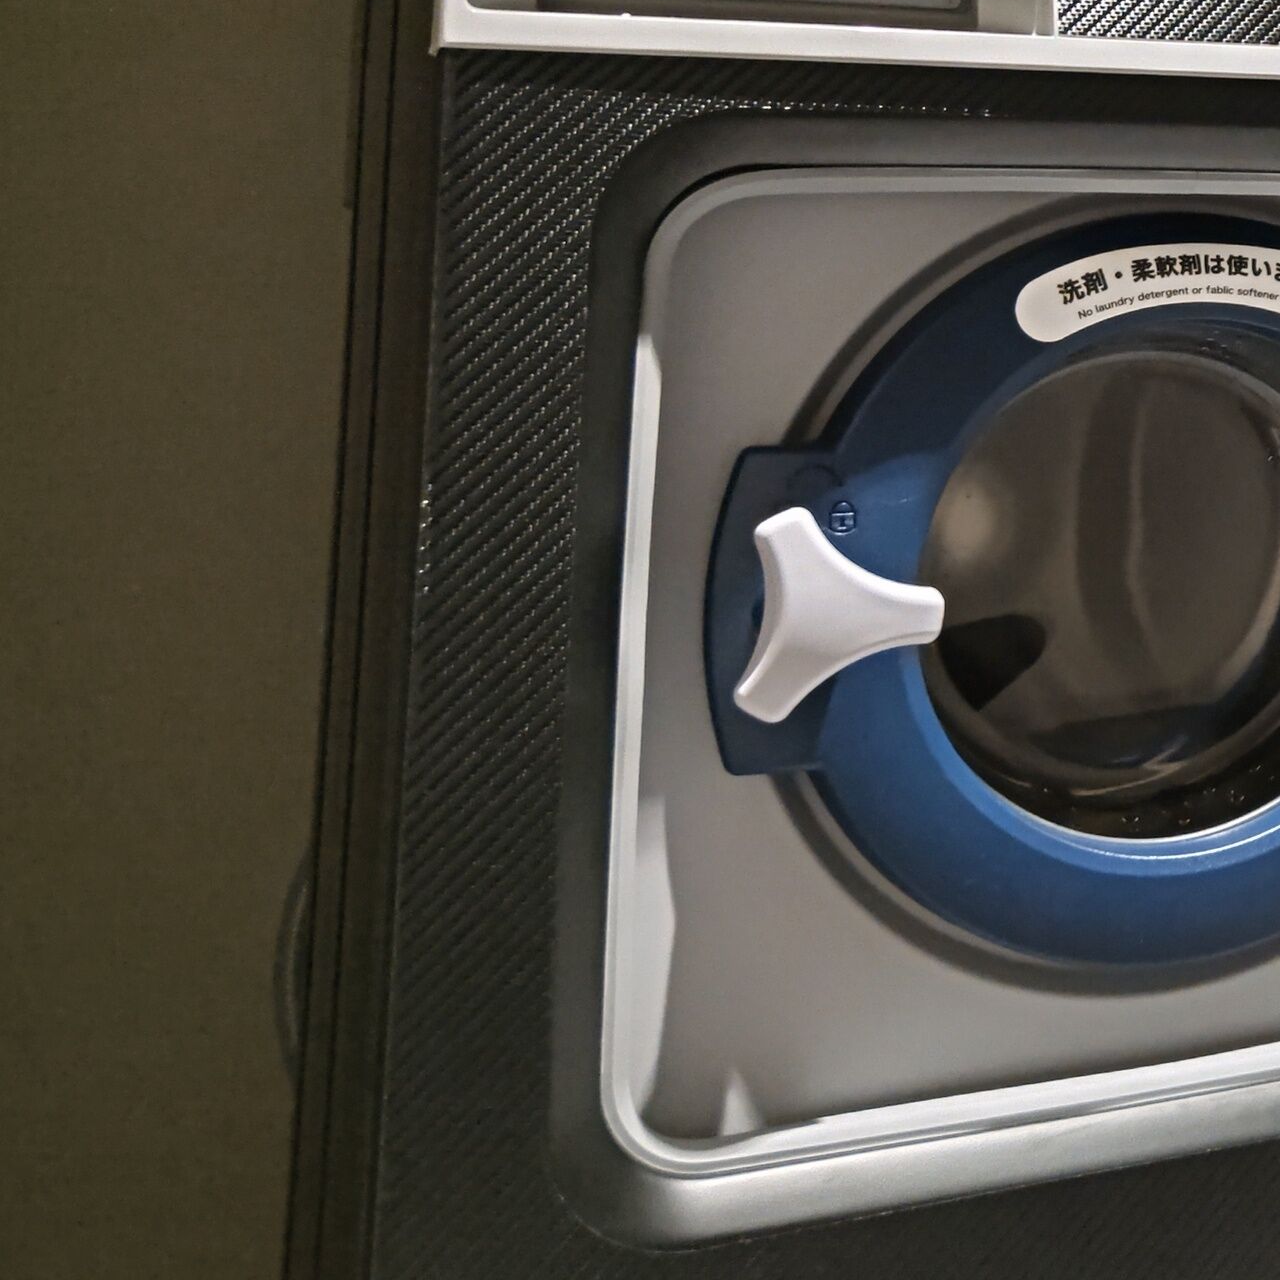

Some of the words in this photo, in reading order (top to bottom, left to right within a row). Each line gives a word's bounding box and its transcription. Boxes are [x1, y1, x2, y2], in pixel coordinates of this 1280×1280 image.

[1078, 309, 1093, 320] No
[1095, 295, 1135, 312] laundry
[1138, 286, 1189, 302] detergent
[1192, 287, 1203, 295] or
[1206, 285, 1233, 295] fablic
[1237, 287, 1280, 300] softener
